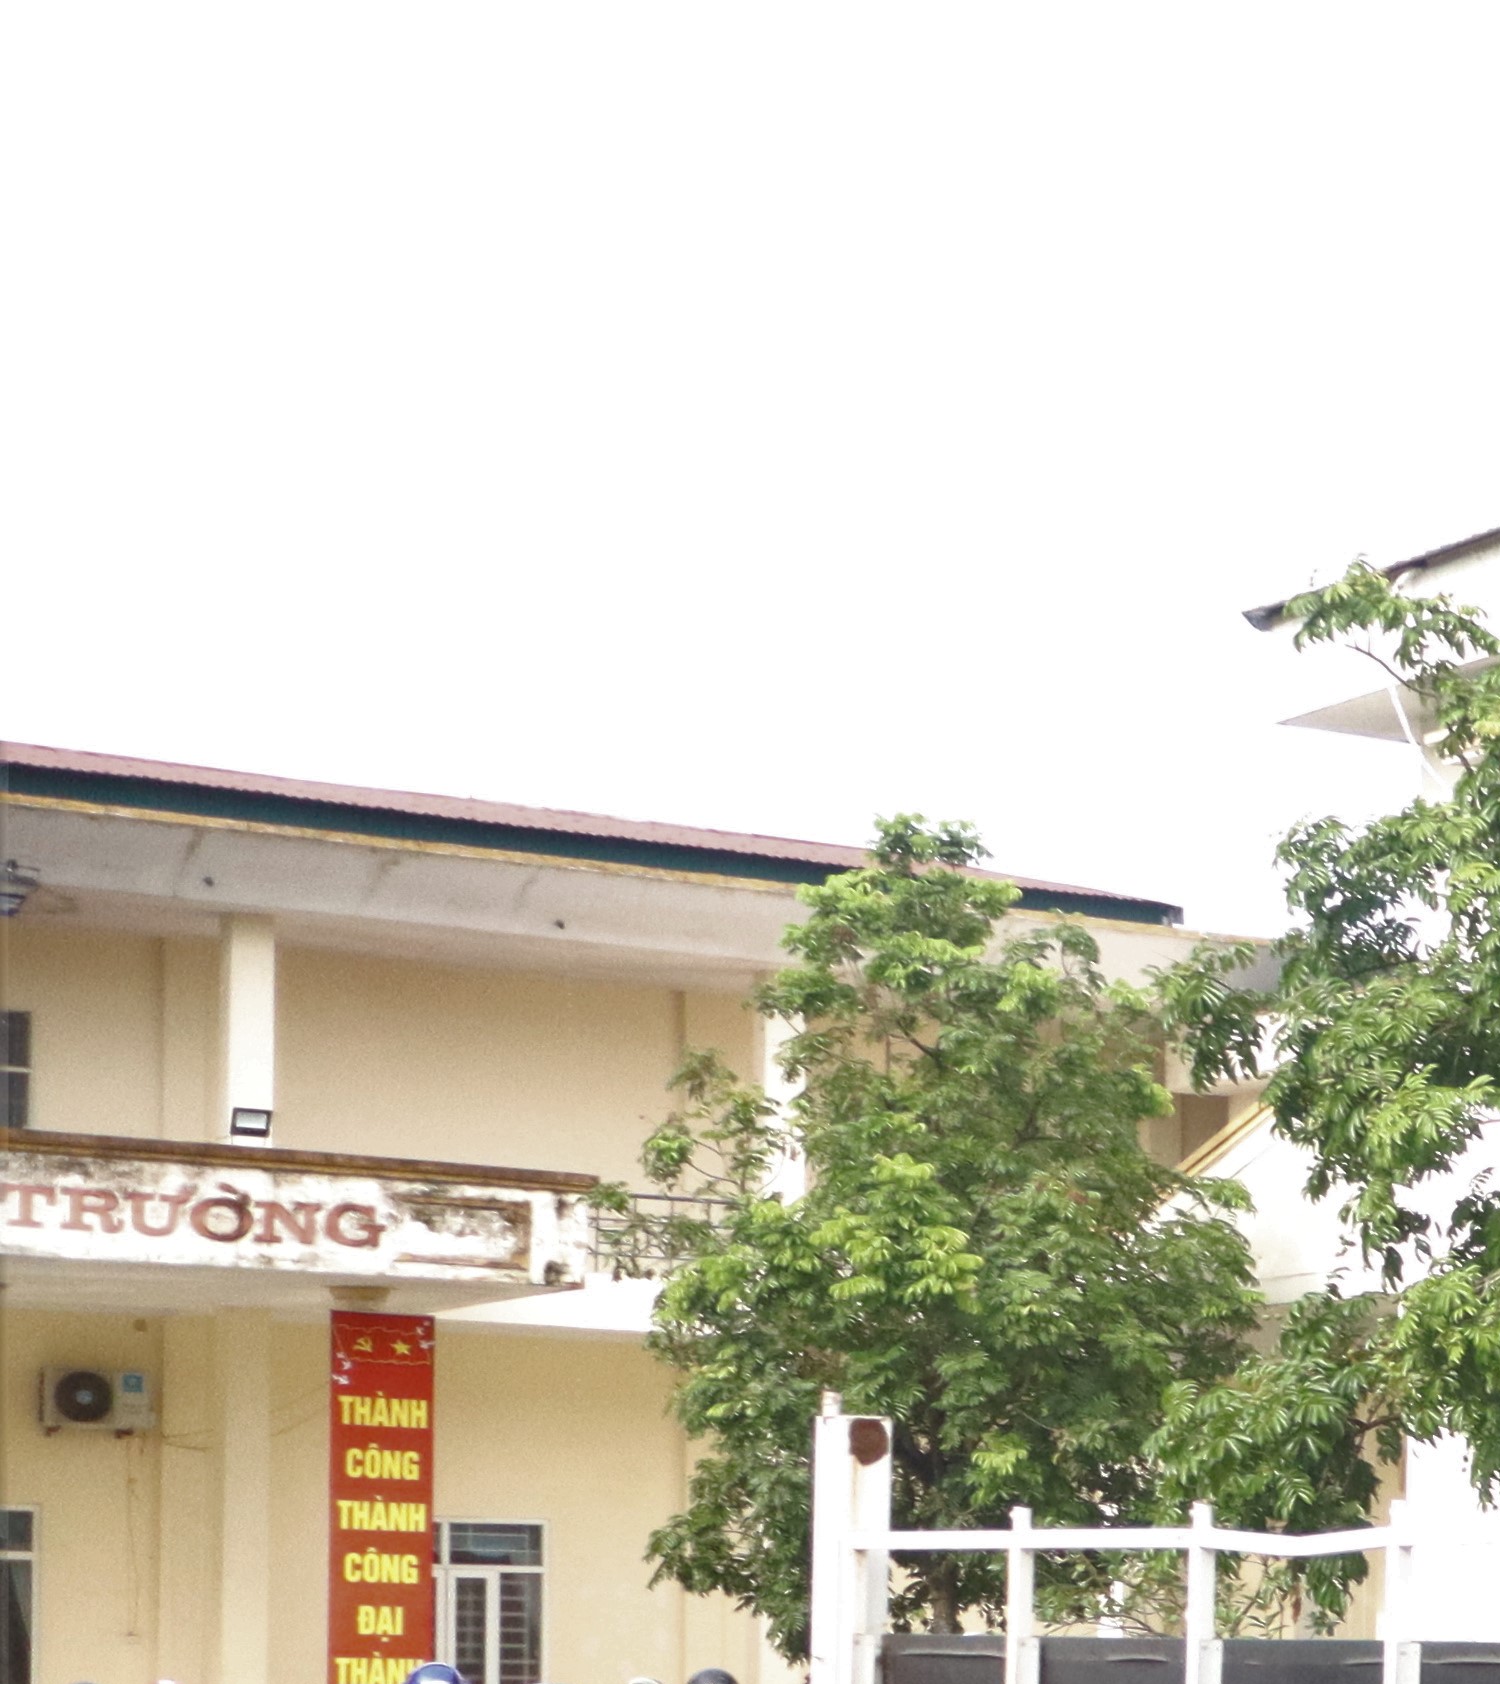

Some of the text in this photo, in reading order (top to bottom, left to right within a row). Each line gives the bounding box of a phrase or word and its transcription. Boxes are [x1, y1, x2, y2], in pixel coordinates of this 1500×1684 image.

[2, 1182, 386, 1248] TRƯỜNG
[337, 1390, 428, 1429] THÀNH
[345, 1443, 420, 1480] CÔNG
[336, 1495, 427, 1532] THÀNH
[343, 1548, 419, 1584] CÔNG
[357, 1605, 404, 1642] ĐẠI
